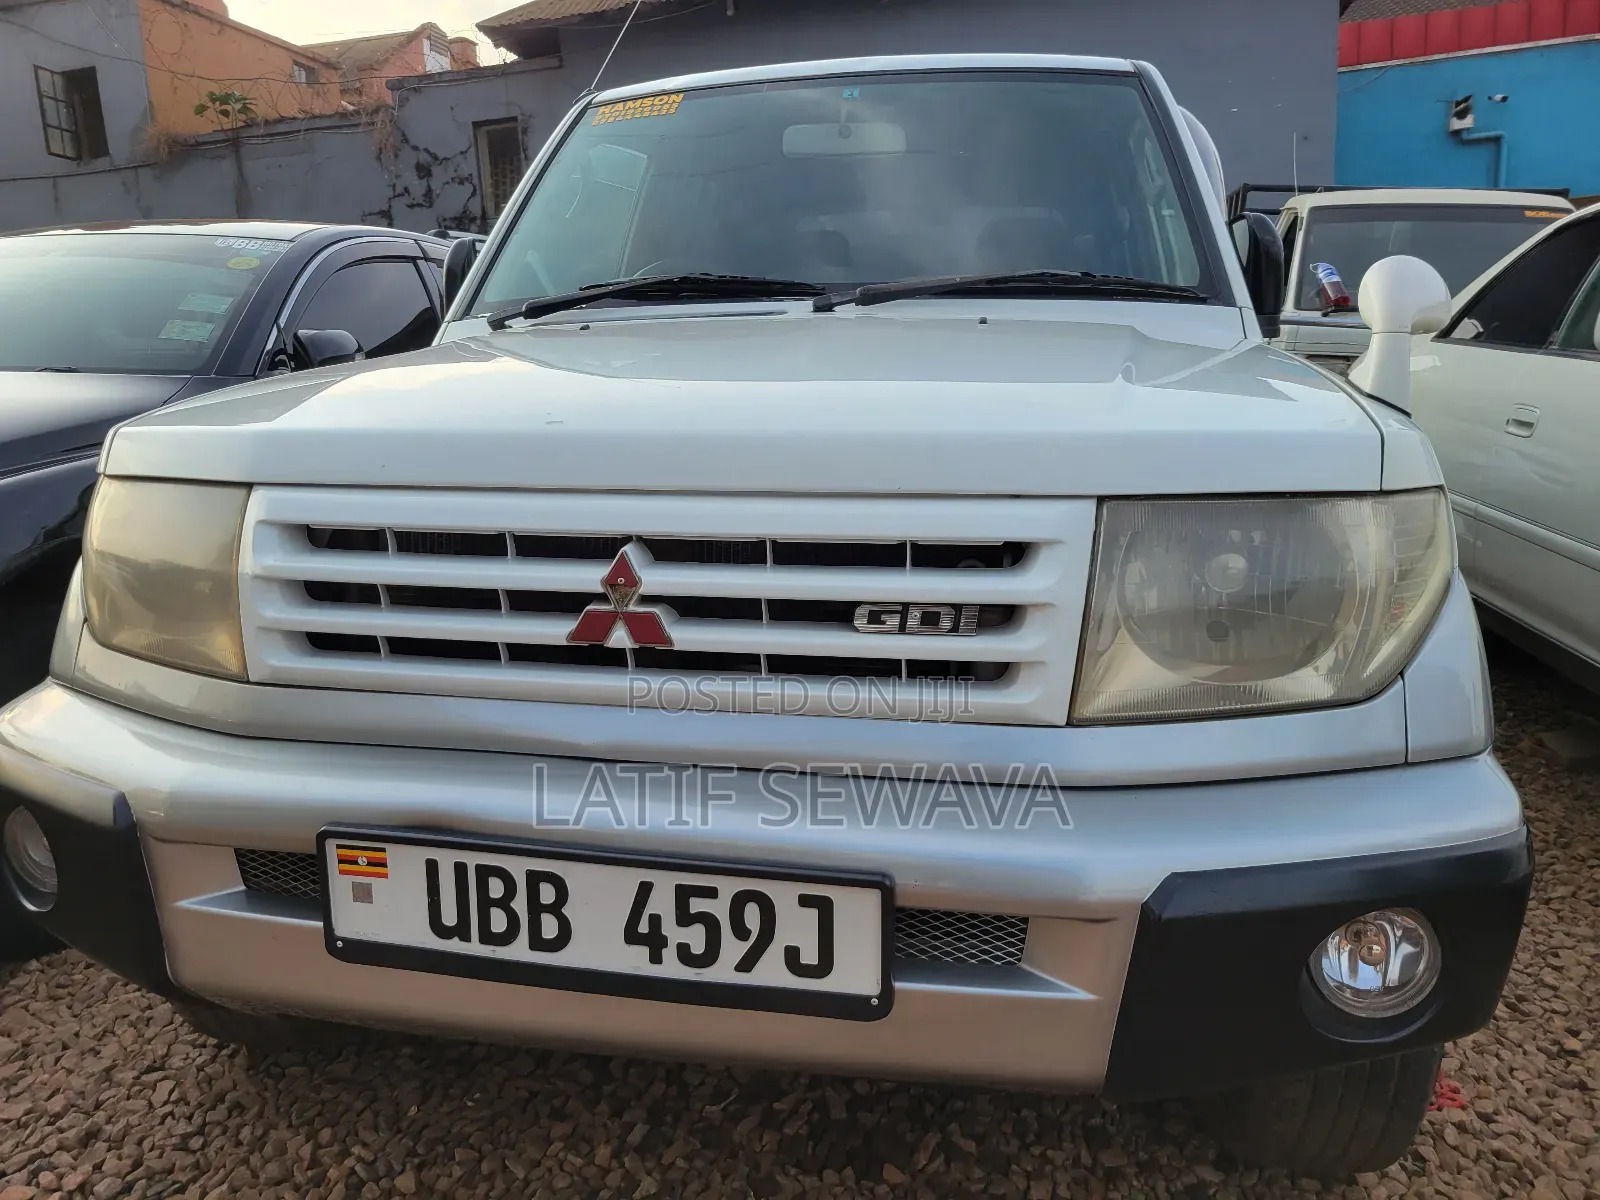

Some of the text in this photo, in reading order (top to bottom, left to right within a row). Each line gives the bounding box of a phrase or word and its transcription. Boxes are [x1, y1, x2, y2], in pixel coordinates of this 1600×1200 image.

[597, 93, 684, 115] HAMSON
[853, 603, 980, 635] GDI
[425, 857, 835, 979] UBB 459J
